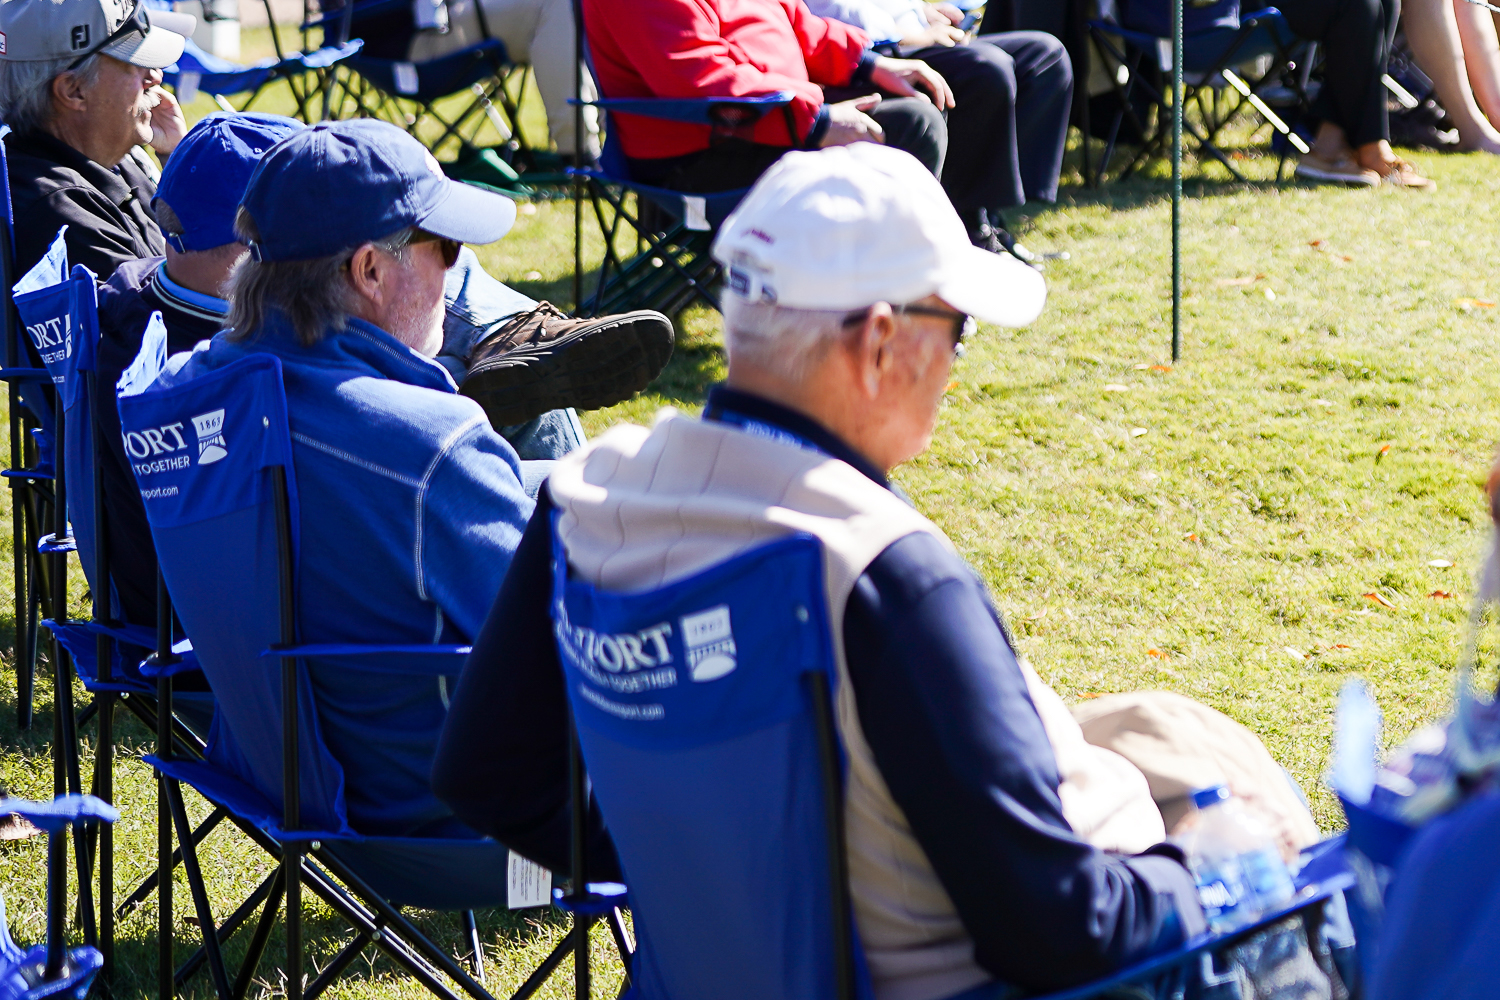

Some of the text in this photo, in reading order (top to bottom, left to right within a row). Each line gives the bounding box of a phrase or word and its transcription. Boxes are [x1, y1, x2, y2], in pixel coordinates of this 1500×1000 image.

[71, 24, 91, 51] FJ
[199, 417, 221, 431] 1863
[135, 455, 190, 476] TOGETHER
